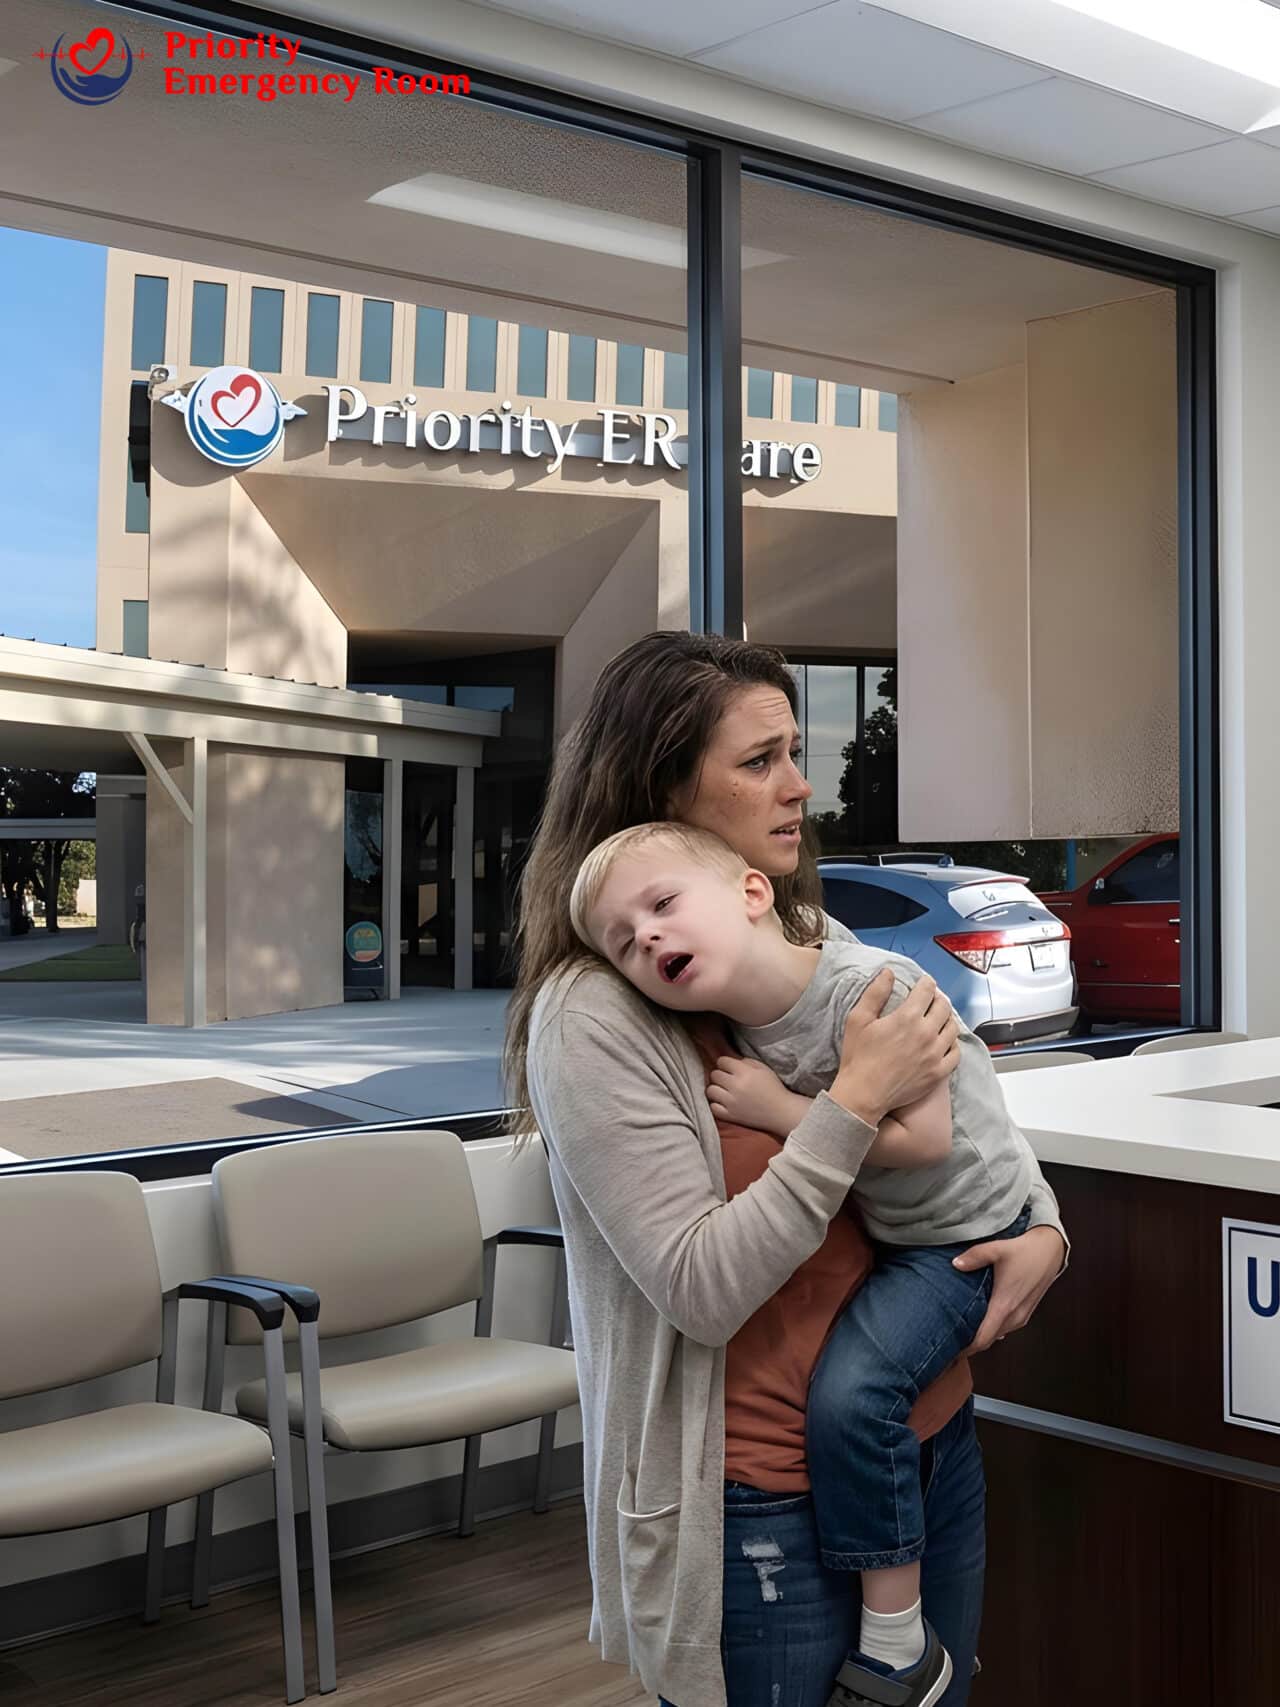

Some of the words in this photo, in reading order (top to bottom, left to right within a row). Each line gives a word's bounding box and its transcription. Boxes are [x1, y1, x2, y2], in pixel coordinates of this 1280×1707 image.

[323, 384, 580, 474] Priority
[597, 408, 682, 471] ER
[741, 437, 823, 483] are
